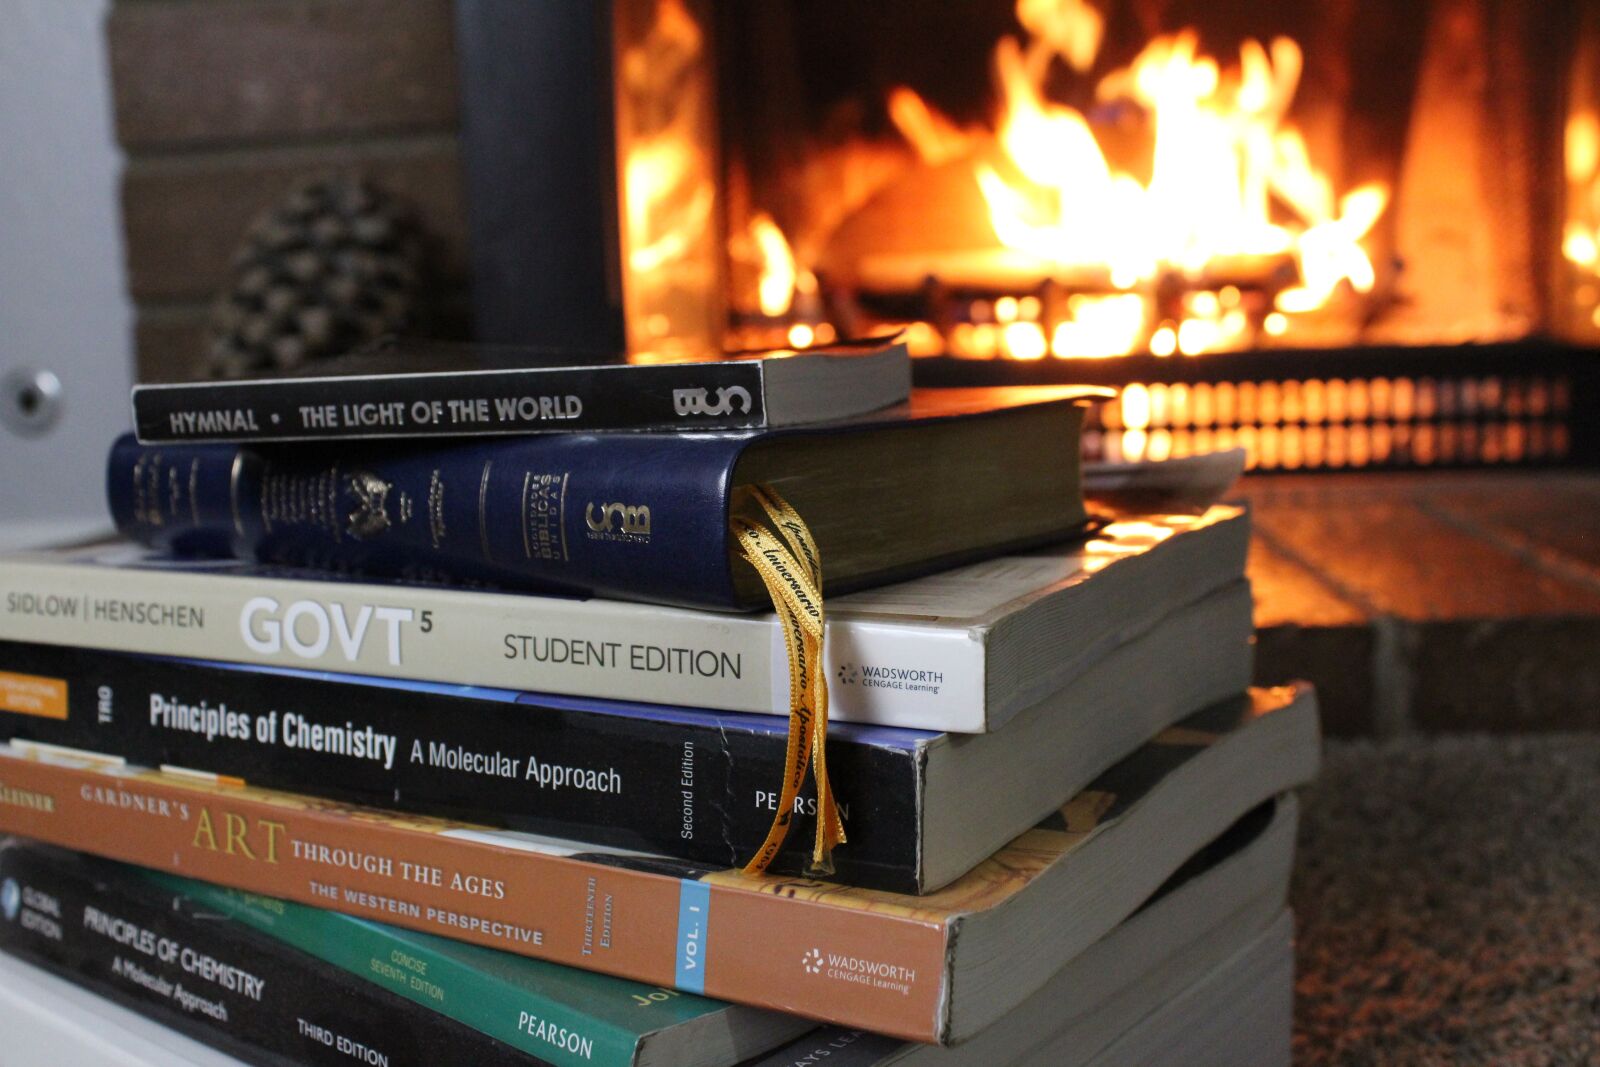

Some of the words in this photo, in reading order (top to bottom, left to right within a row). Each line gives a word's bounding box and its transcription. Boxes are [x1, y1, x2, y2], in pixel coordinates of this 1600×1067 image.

[169, 409, 259, 434] HYMNAL
[299, 405, 337, 428] THE
[343, 401, 404, 427] LIGHT
[411, 400, 443, 424] OF
[447, 397, 489, 423] THE
[495, 395, 583, 422] WORLD
[6, 591, 78, 619] SIDLOW
[95, 600, 205, 629] HENSCHEN
[239, 595, 414, 666] GOVT
[420, 610, 433, 634] 5
[503, 633, 622, 669] STUDENT
[630, 644, 742, 680] EDITION
[861, 665, 943, 684] WADSWORTH
[97, 685, 113, 723] TRO
[862, 679, 903, 689] CENGAGE
[905, 682, 939, 695] Learning
[149, 692, 251, 743] Principles
[256, 712, 278, 744] of
[283, 714, 397, 770] Chemistry
[410, 738, 424, 765] A
[429, 741, 519, 781] Molecular
[525, 755, 622, 795] Approach
[681, 741, 694, 787] Edition
[0, 782, 55, 813] LEINER
[681, 790, 693, 840] Second
[755, 790, 849, 821] PERSN
[80, 783, 190, 822] GARDNER'S
[191, 806, 286, 864] ART
[291, 839, 394, 878] THROUGH
[399, 861, 442, 887] THE
[449, 872, 506, 900] AGES
[309, 880, 338, 900] THE
[344, 888, 421, 919] WESTERN
[426, 908, 544, 946] PERSPECTIVE
[83, 905, 156, 956] PRINCIPLES
[158, 935, 179, 963] OF
[180, 946, 265, 1001] CHEMISTRY
[390, 949, 427, 976] CONCISE
[684, 923, 698, 970] VOL.
[828, 953, 915, 983] WADSWORTH
[111, 956, 123, 972] A
[123, 959, 174, 999] Molecular
[173, 983, 228, 1022] Approach
[370, 957, 406, 985] SEVENTH
[410, 973, 444, 1002] EDITION
[827, 968, 871, 985] CENGAGE
[873, 977, 909, 995] Learning
[297, 1017, 334, 1047] THIRD
[336, 1036, 389, 1067] EDITION
[518, 1010, 593, 1060] PEARSON
